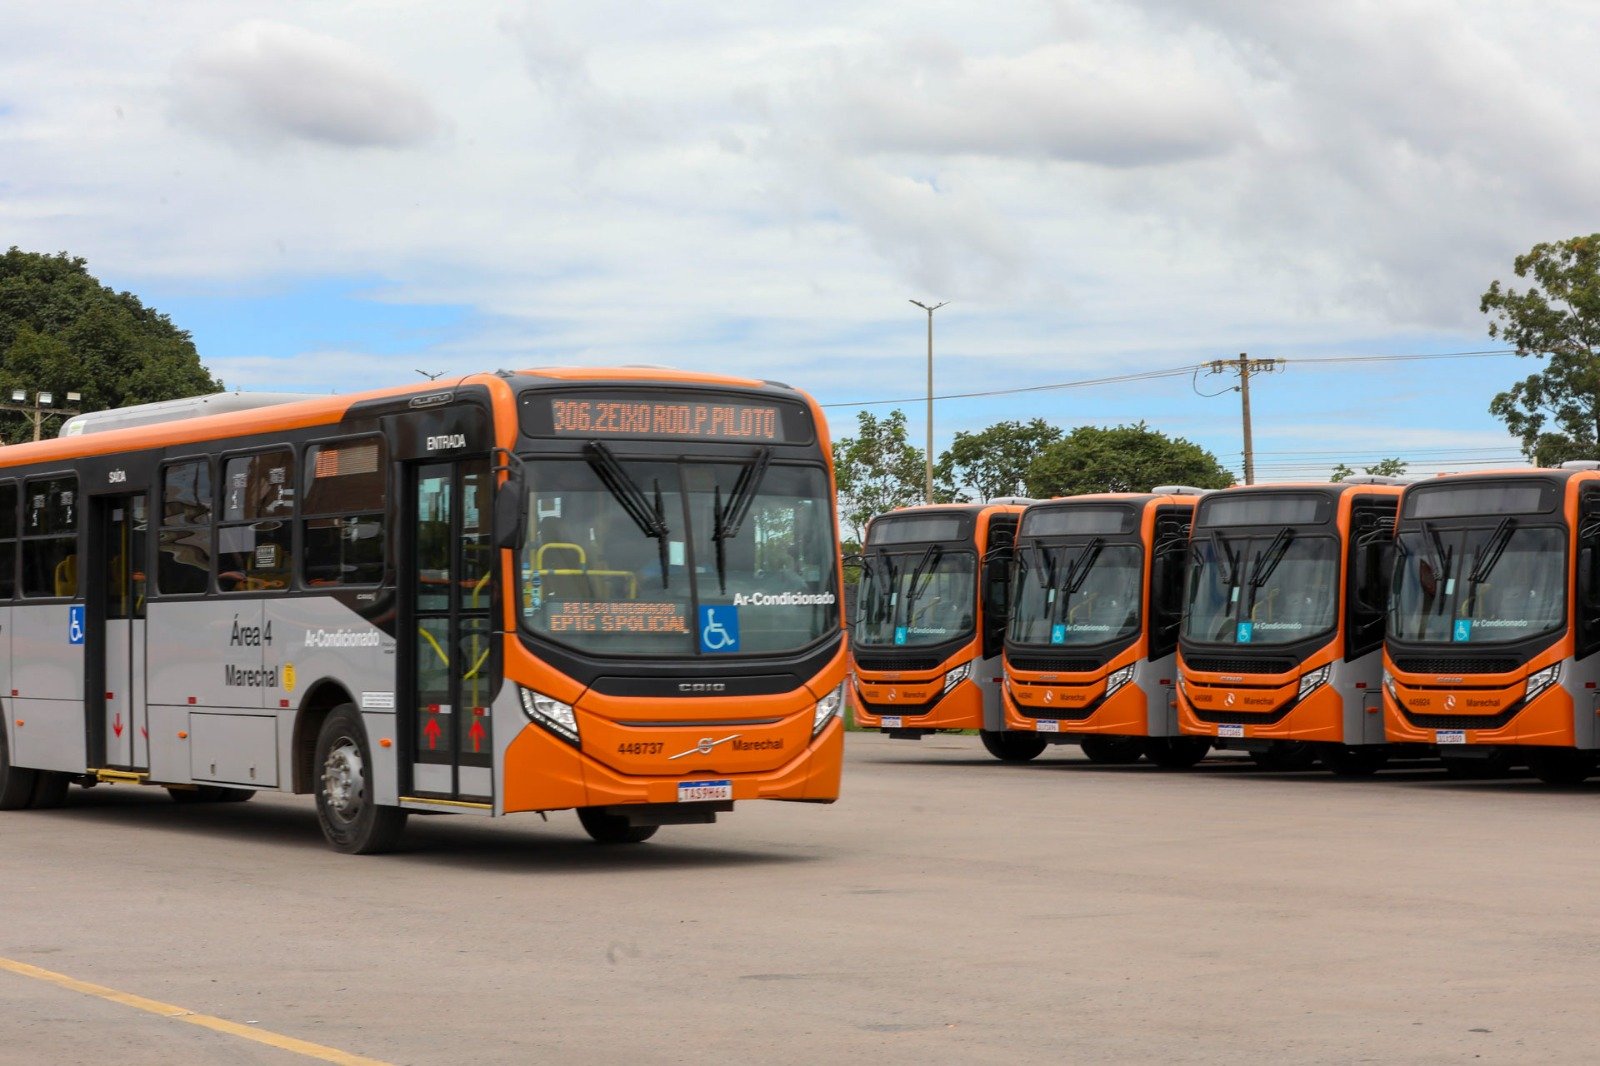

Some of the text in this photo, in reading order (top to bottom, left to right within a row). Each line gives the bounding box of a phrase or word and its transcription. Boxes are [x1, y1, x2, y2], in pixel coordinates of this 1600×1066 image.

[426, 433, 466, 450] ENTRADA
[108, 468, 127, 484] SAÍDA
[733, 592, 836, 606] Ar-Condicionado
[1260, 622, 1302, 630] Condicionado
[1481, 619, 1528, 627] Condicionado
[230, 613, 272, 647] Área 4
[304, 628, 380, 648] Ar-Condicionado
[225, 664, 279, 688] Marechal
[678, 683, 726, 692] CAIO
[1243, 697, 1275, 705] Marechal
[1466, 699, 1501, 707] Marechal
[618, 742, 664, 755] 448737
[732, 738, 784, 751] Marechal
[683, 788, 728, 800] TAS9H66
